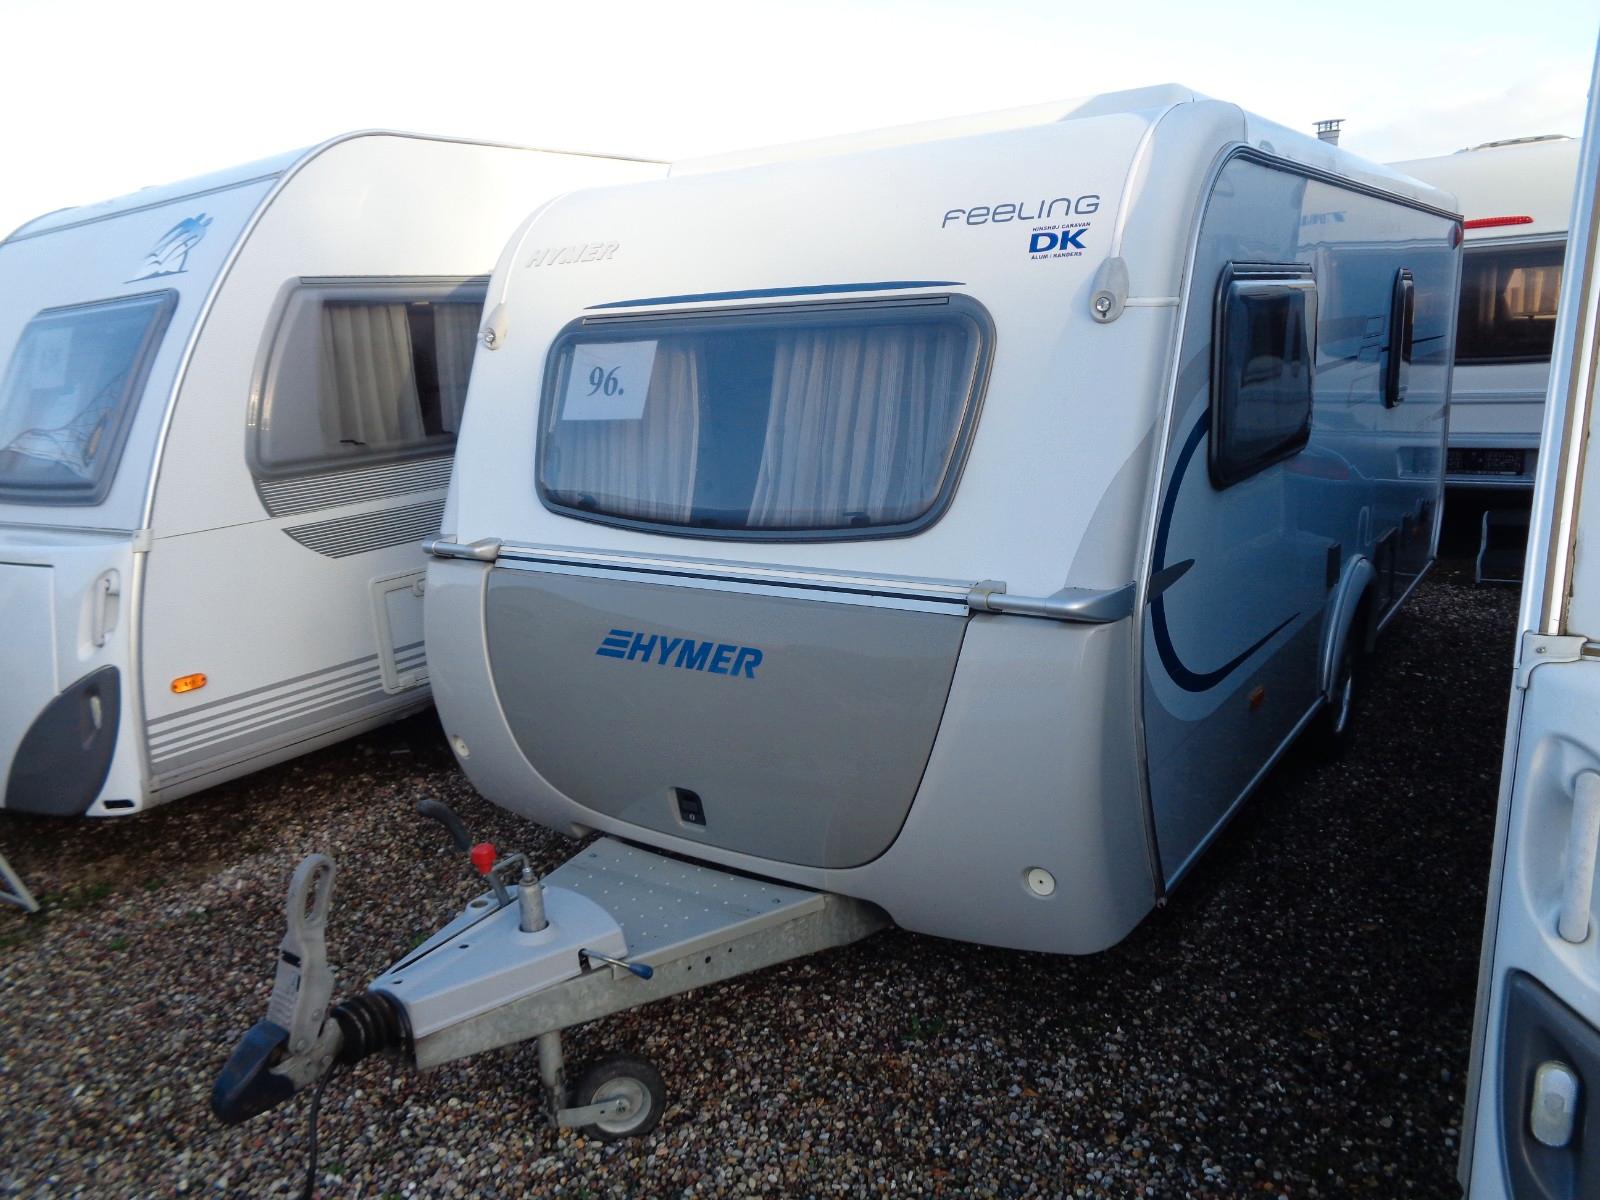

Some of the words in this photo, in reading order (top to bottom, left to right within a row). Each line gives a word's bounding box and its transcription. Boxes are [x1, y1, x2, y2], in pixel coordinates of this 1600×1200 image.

[1028, 228, 1088, 253] DK
[586, 366, 624, 396] 96.
[626, 632, 763, 679] HYMER
